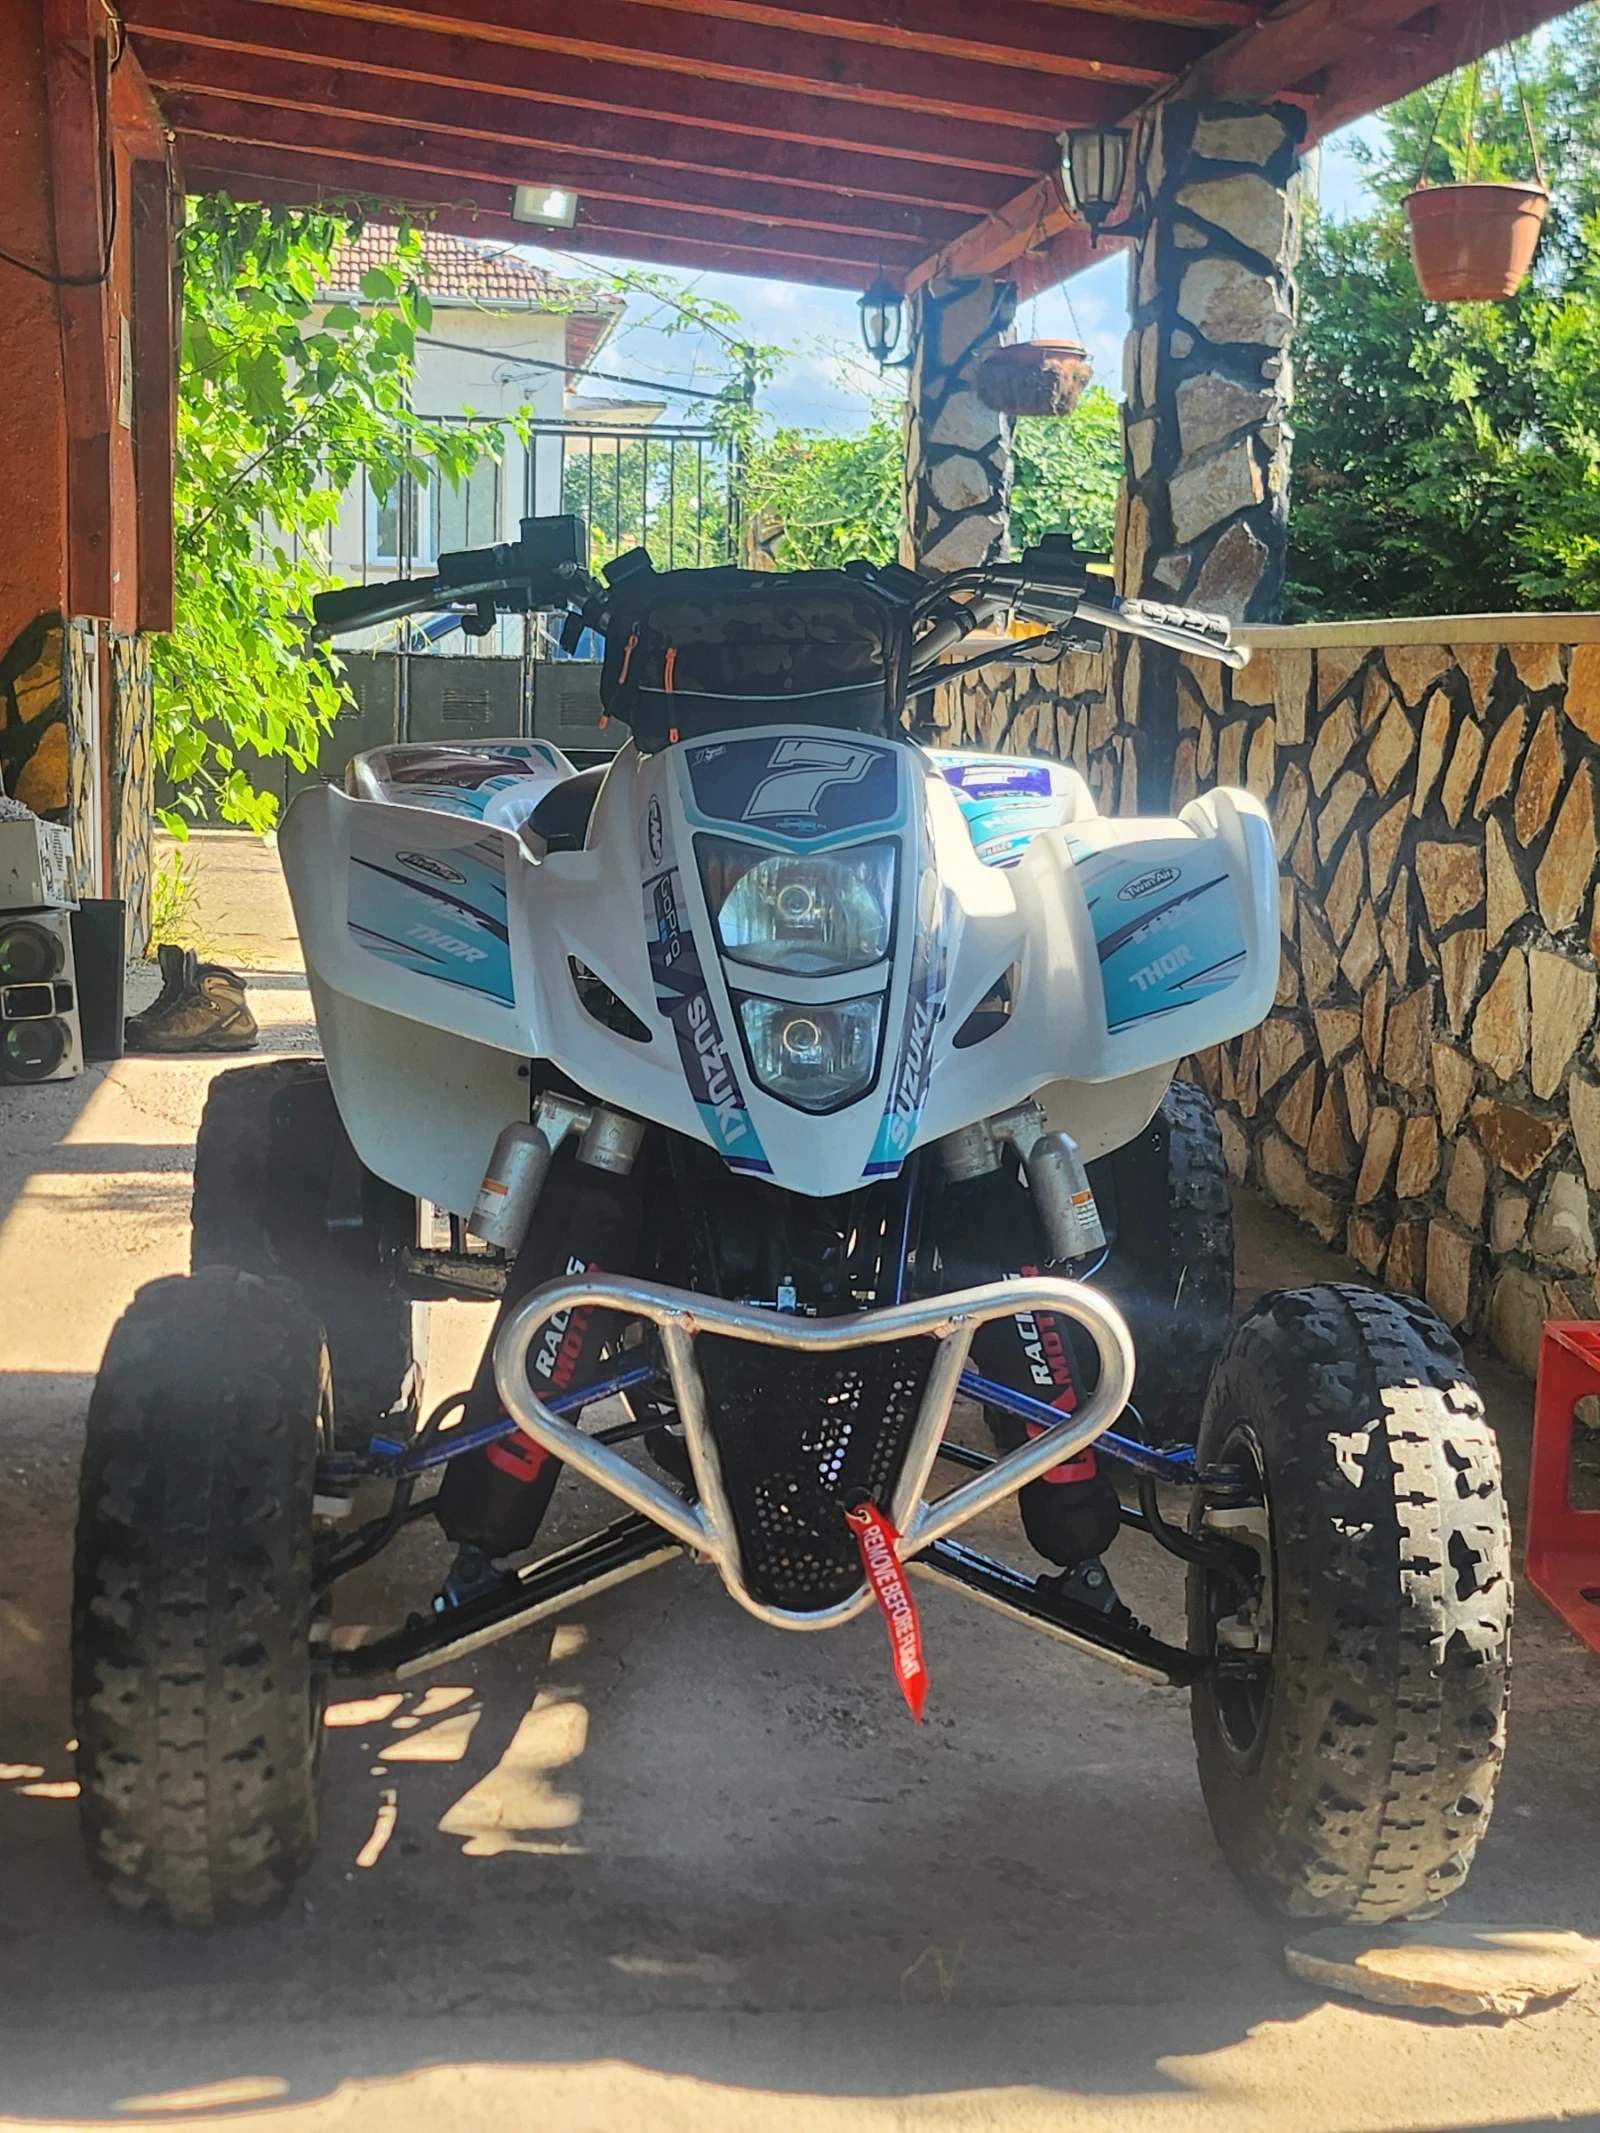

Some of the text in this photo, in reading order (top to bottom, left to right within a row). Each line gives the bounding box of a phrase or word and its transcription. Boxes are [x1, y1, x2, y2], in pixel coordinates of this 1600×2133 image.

[741, 737, 886, 821] 7
[405, 923, 489, 963] THOR
[660, 877, 682, 958] GoPro
[1128, 944, 1196, 992] THOR
[687, 995, 747, 1147] SUZUKI
[891, 1004, 934, 1151] SUZUKI
[862, 1524, 921, 1680] REMOVE BEFORE FLIGHT
